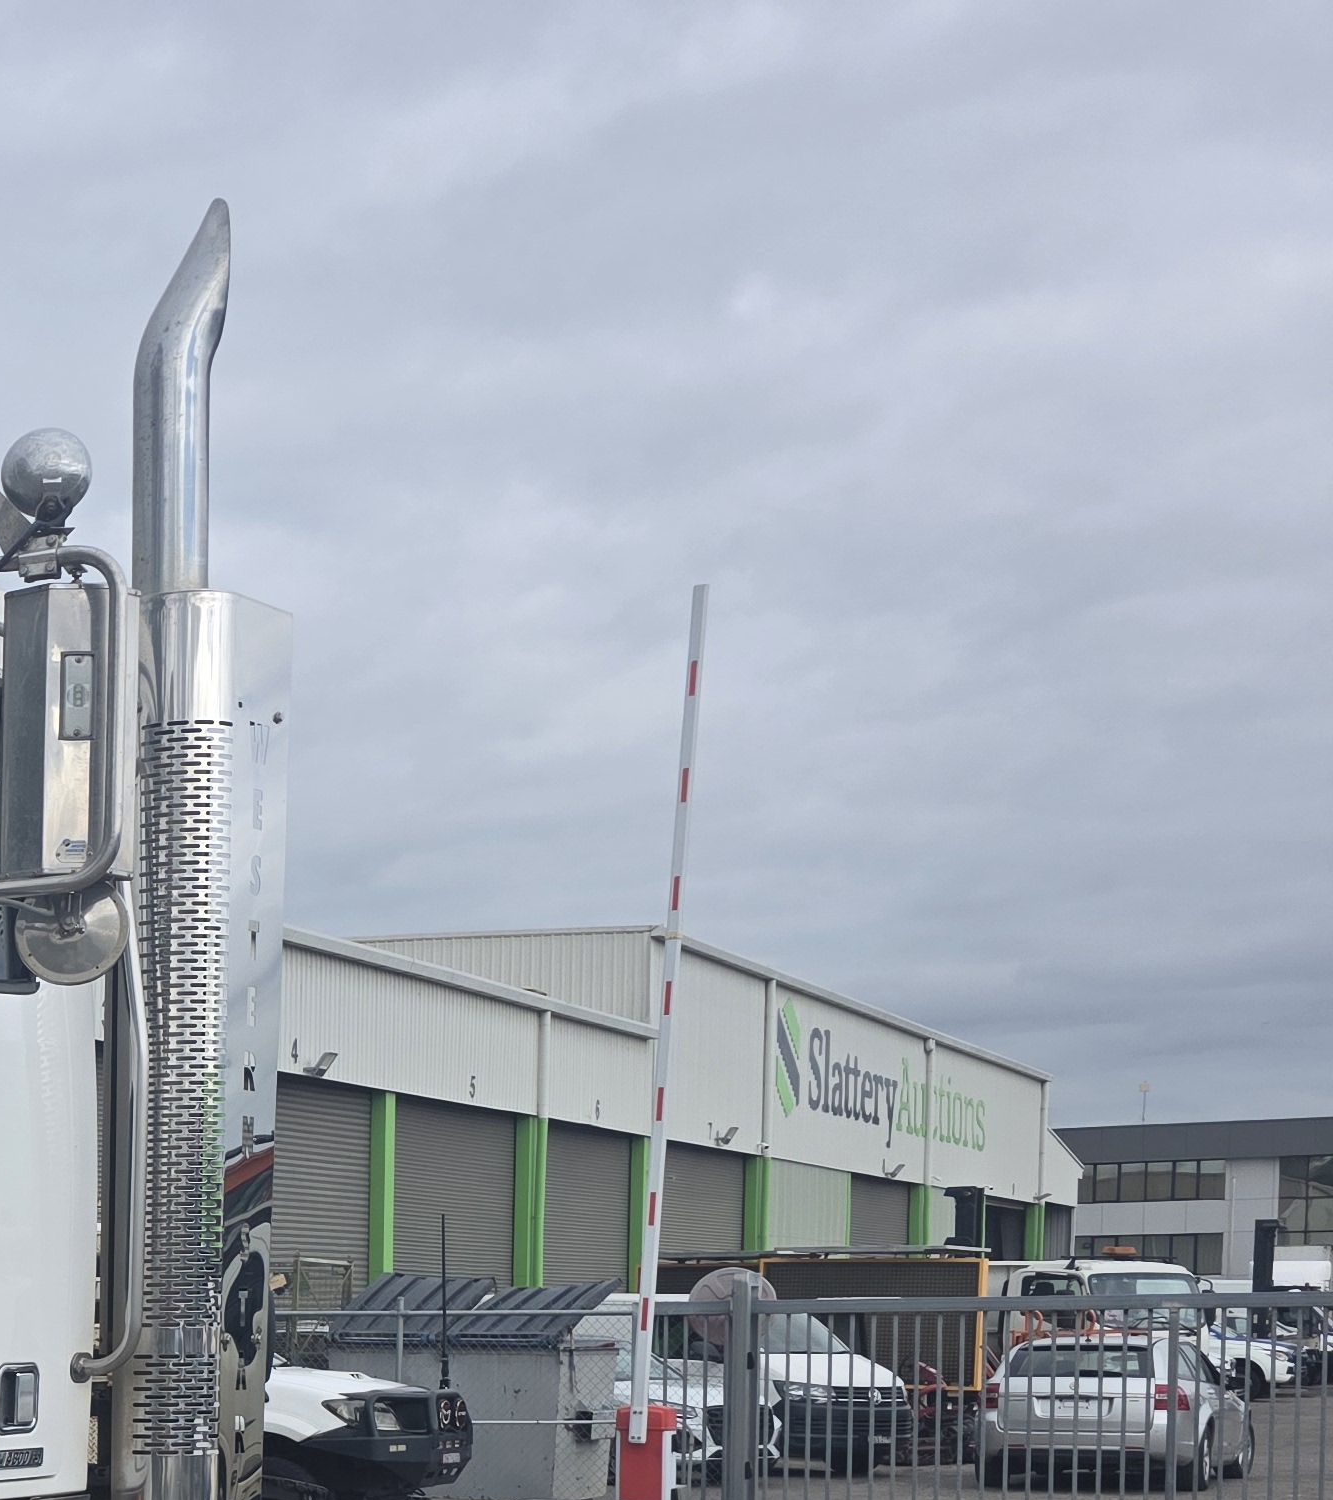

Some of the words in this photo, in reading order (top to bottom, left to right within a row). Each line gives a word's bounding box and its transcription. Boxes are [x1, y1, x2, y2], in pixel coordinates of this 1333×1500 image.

[290, 1037, 299, 1064] 4
[468, 1075, 476, 1099] 5
[594, 1099, 600, 1121] 6
